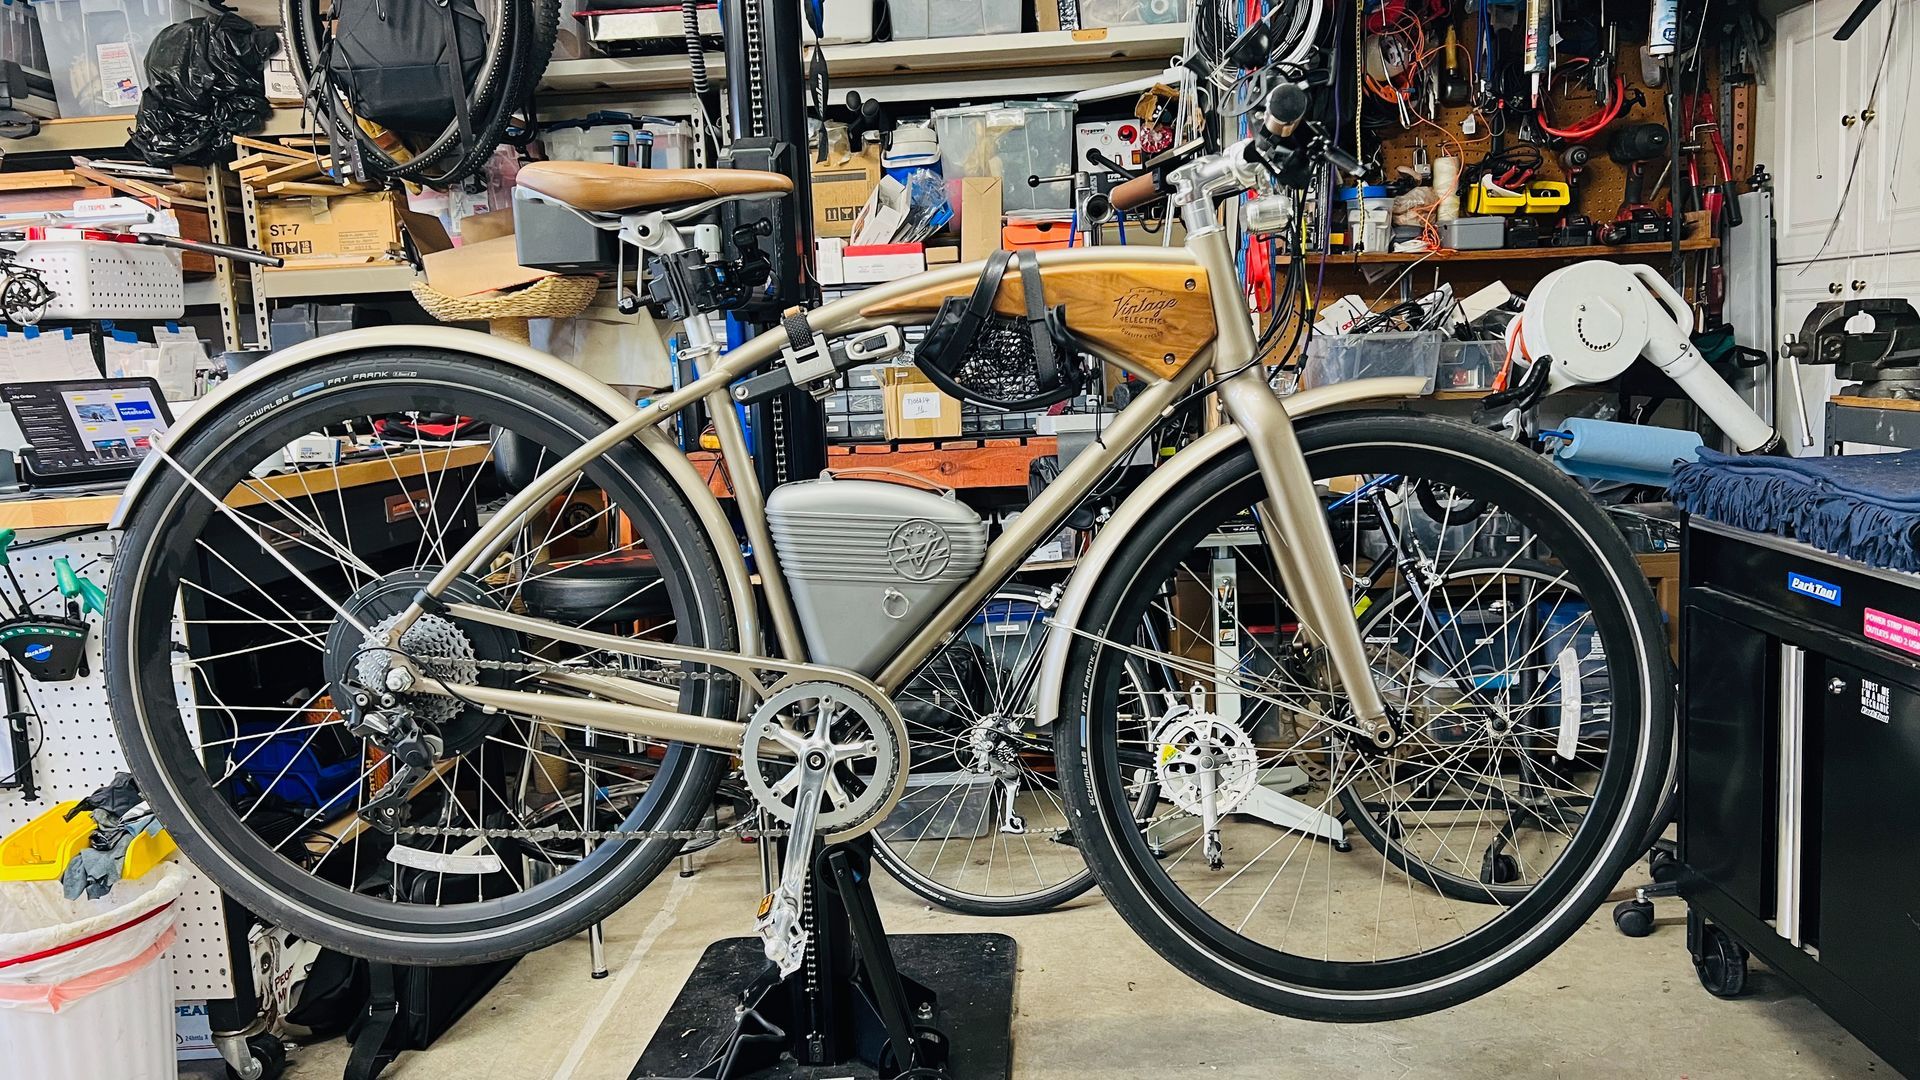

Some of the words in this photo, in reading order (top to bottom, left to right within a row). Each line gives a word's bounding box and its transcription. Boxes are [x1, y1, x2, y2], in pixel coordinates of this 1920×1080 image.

[270, 224, 300, 237] ST-7
[1113, 294, 1178, 318] Vintage
[1124, 316, 1162, 324] ELECTRIC
[237, 395, 290, 428] SCHWALBE
[1903, 637, 1909, 645] 2
[1862, 679, 1878, 692] TRUST
[1881, 686, 1890, 697] ME
[1081, 751, 1095, 806] SCHWALBE
